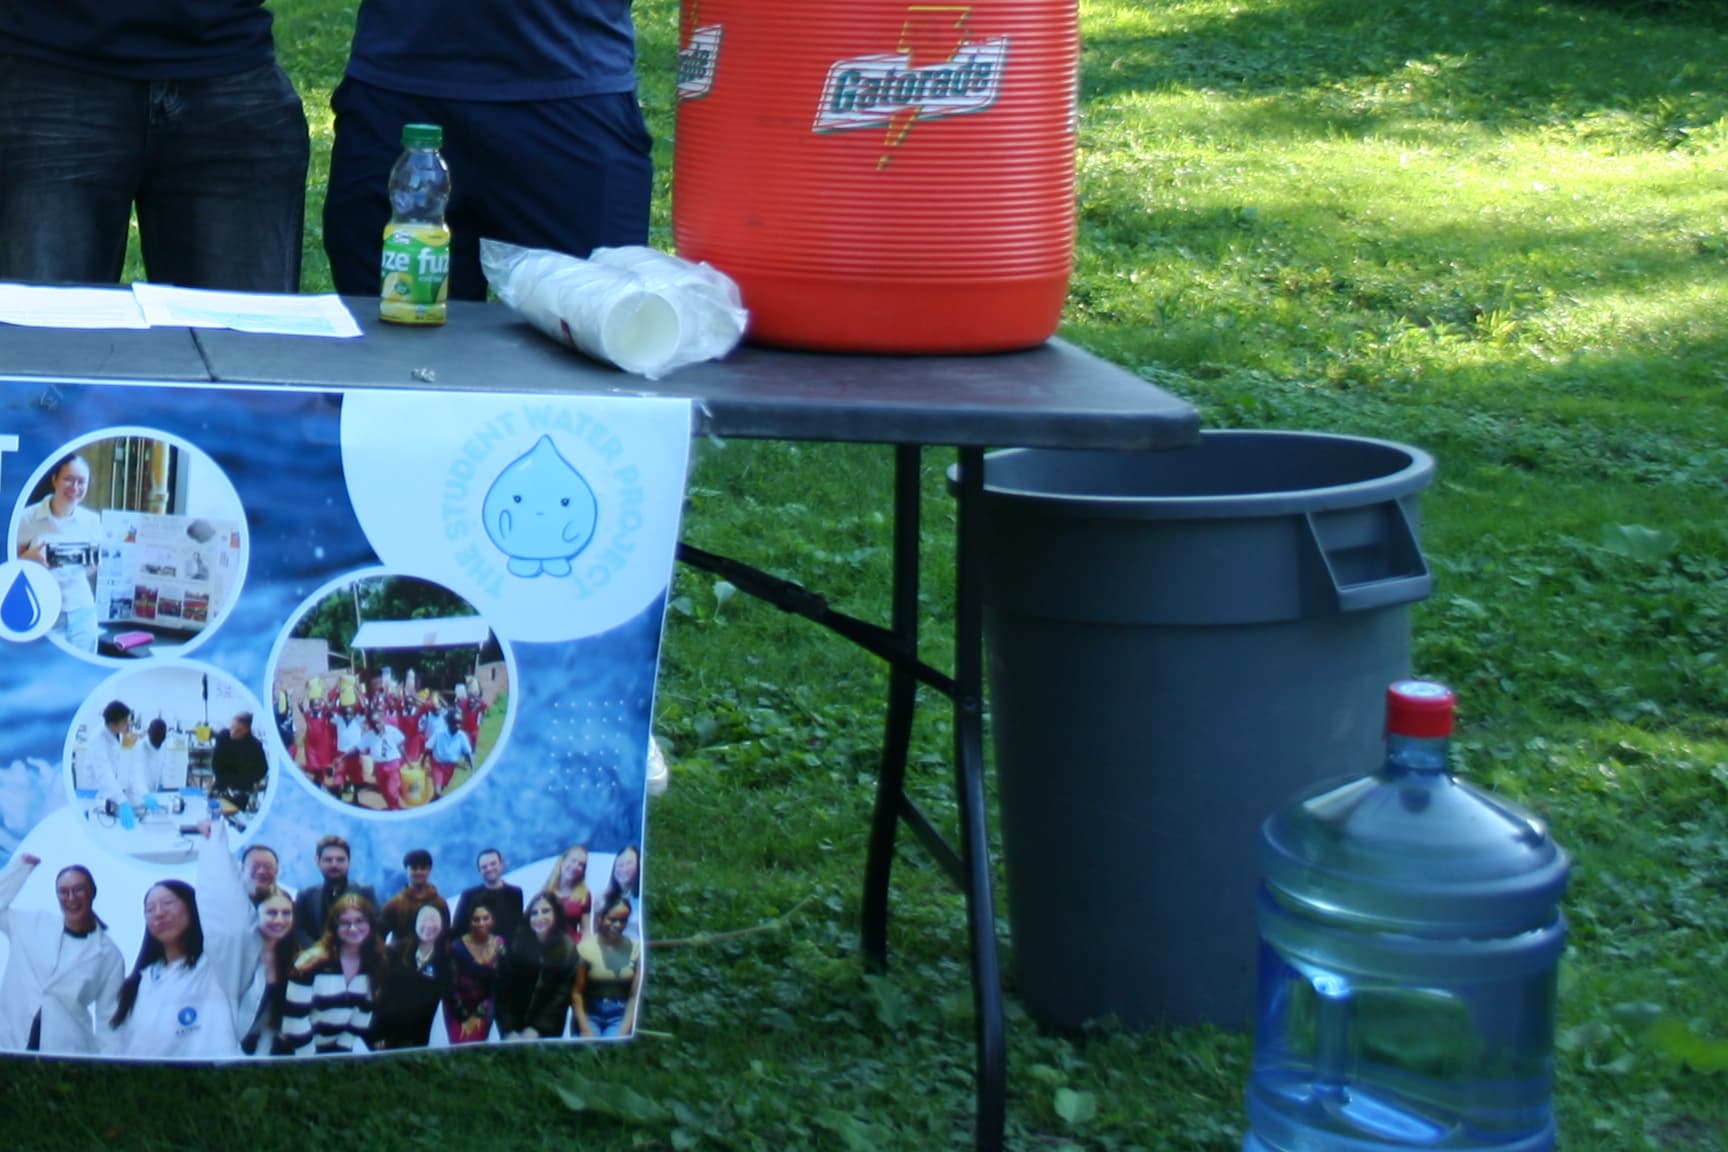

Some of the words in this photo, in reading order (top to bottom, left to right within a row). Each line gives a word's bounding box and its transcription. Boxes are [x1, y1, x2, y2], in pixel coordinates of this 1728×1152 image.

[832, 55, 994, 113] Gatorade
[523, 404, 625, 461] WATER
[441, 411, 517, 540] STUDENT
[575, 463, 645, 599] PROJECT
[454, 541, 506, 598] THE
